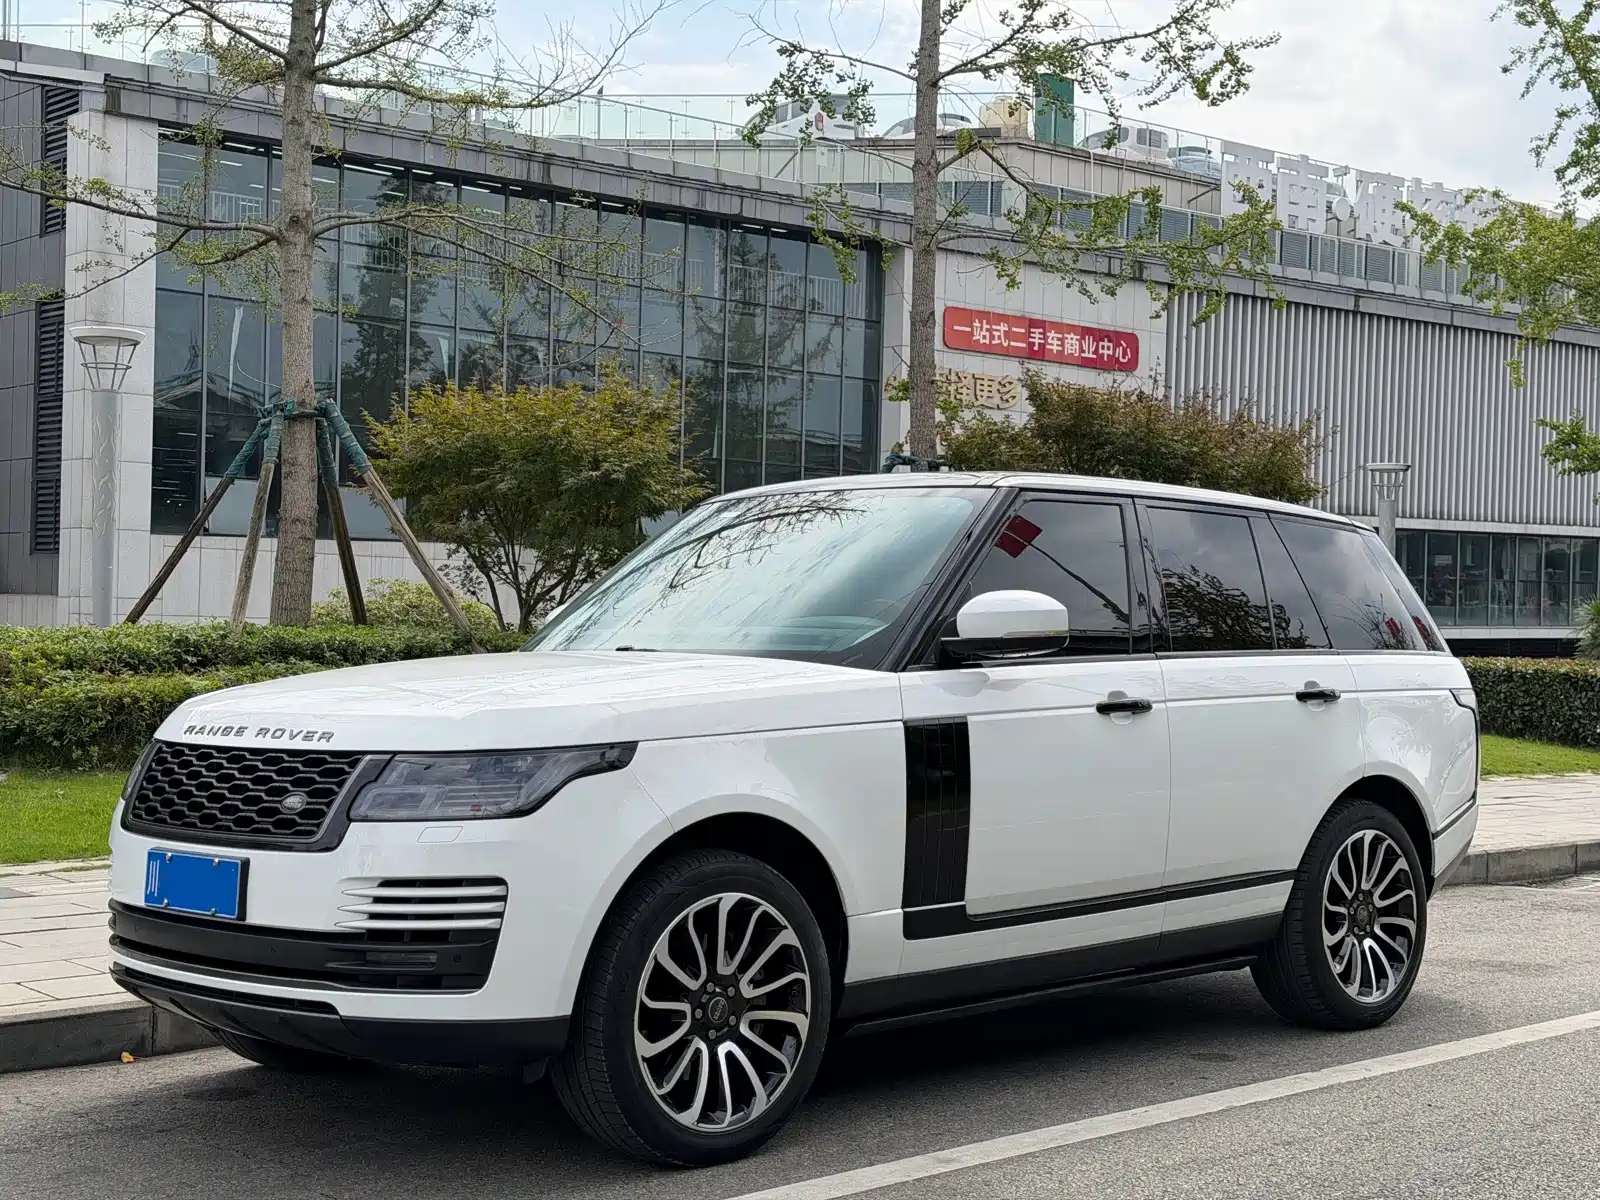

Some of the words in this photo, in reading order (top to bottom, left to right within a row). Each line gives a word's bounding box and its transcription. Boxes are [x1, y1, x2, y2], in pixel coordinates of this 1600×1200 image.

[953, 318, 1132, 363] 一站式二手车商业中心
[936, 368, 1021, 409] 择更多
[183, 724, 249, 738] RANGE
[254, 726, 335, 743] ROVER
[146, 859, 160, 897] 川
